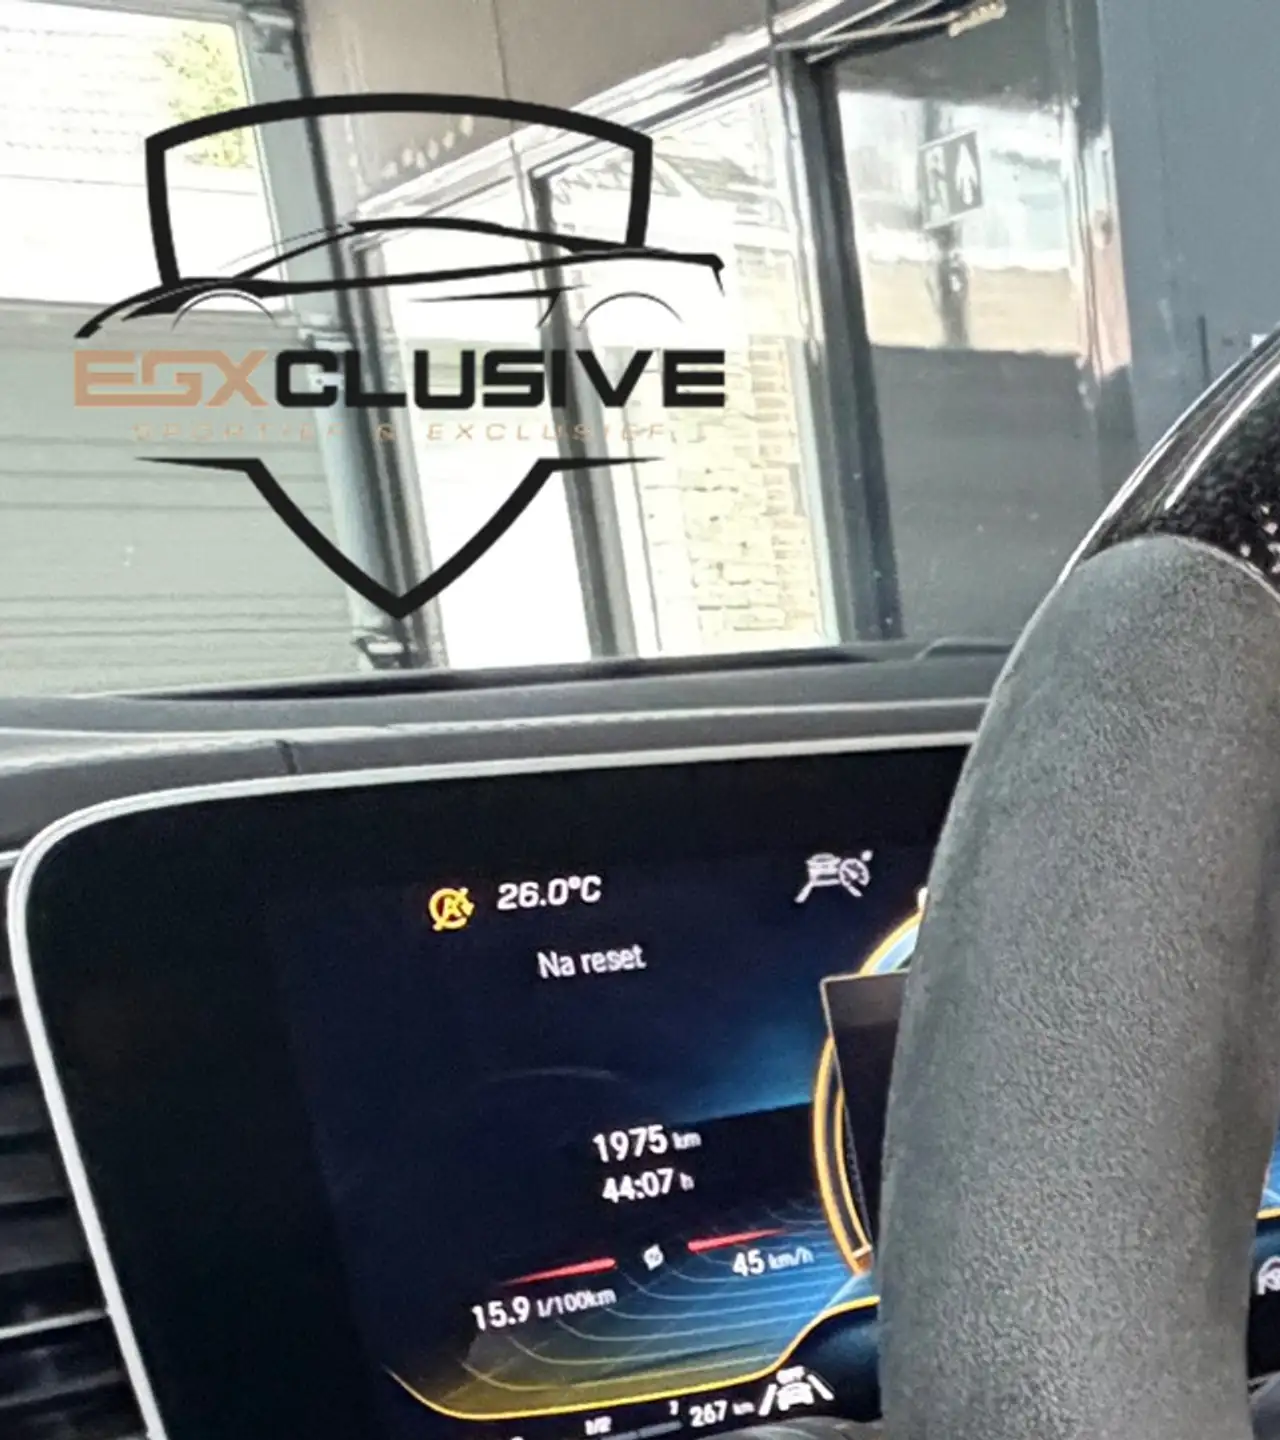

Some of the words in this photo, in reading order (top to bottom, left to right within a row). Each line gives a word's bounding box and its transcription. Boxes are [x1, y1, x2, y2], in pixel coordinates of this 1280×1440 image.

[496, 875, 602, 911] 26.0°C
[536, 950, 576, 979] Na
[580, 944, 647, 975] reset
[593, 1124, 669, 1163] 1975
[673, 1131, 703, 1151] km
[602, 1168, 675, 1204] 44:07
[732, 1249, 766, 1278] 45
[768, 1245, 815, 1271] km/h
[471, 1294, 530, 1331] 15.9
[689, 1399, 728, 1428] 267
